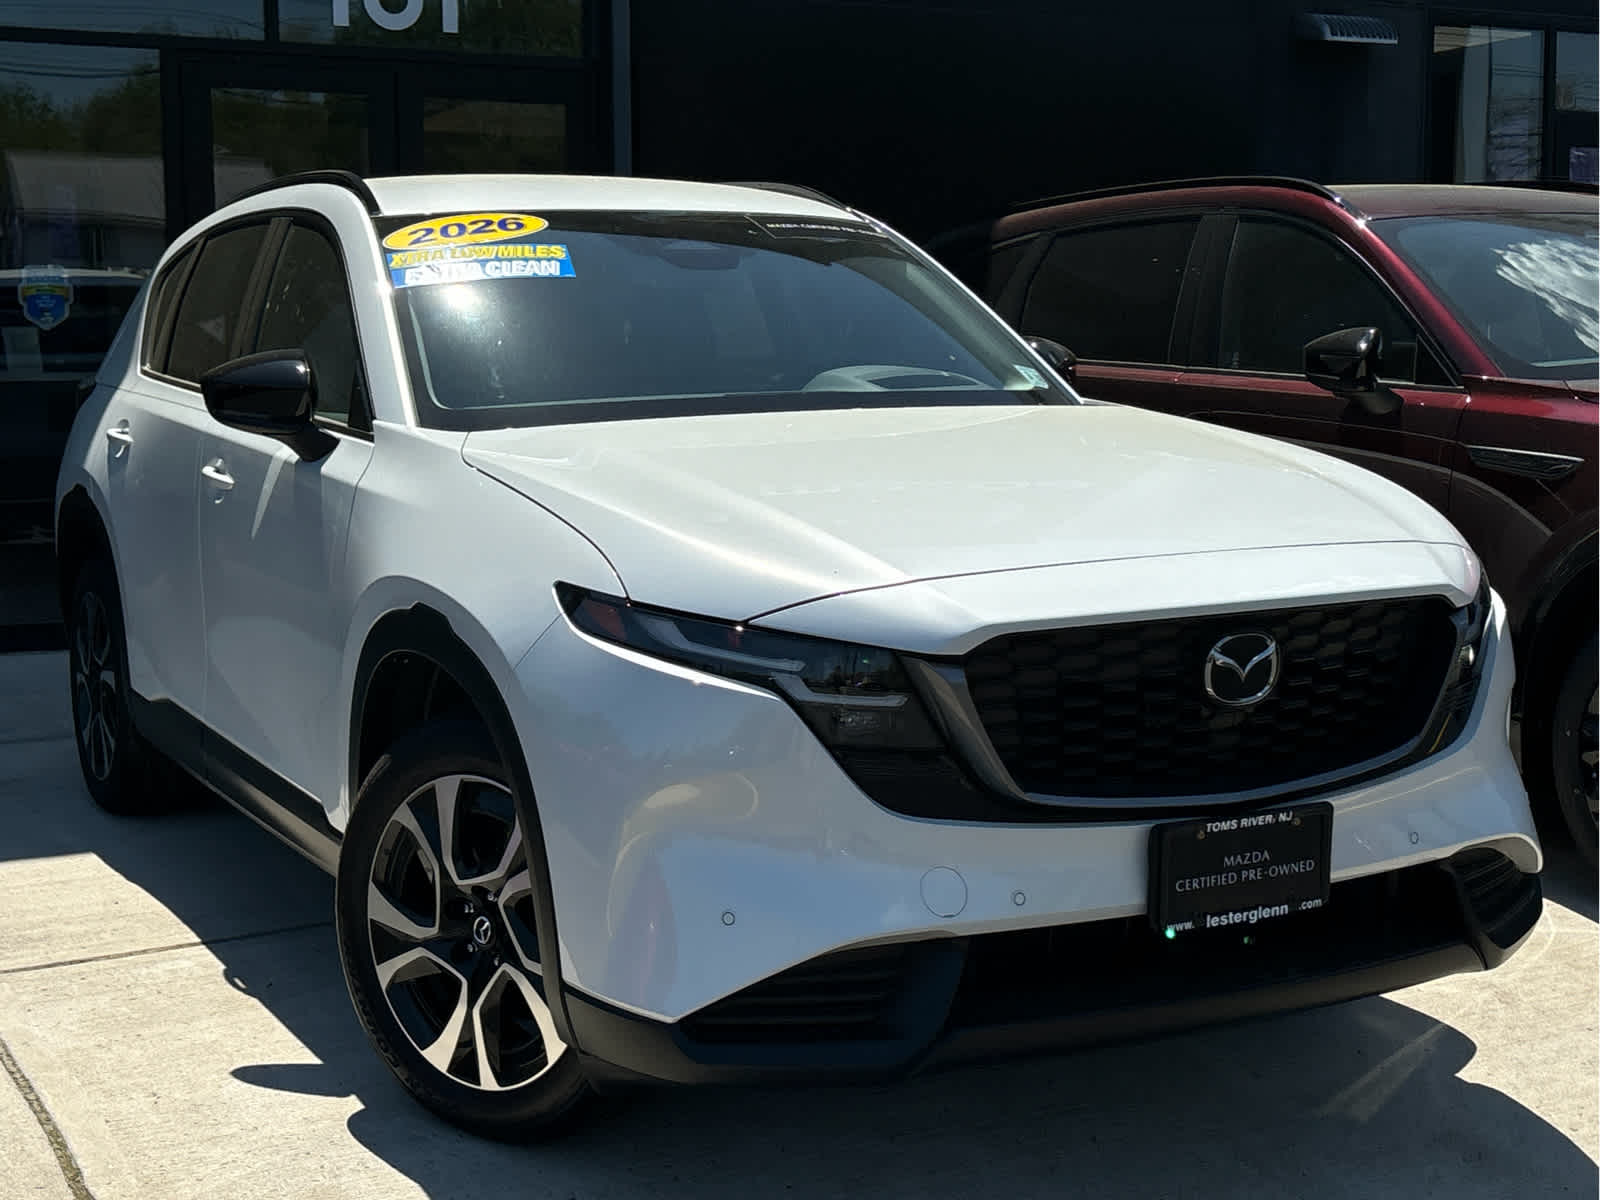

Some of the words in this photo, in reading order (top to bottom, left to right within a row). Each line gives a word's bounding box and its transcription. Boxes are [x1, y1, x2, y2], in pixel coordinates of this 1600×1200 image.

[408, 217, 526, 246] 2026
[449, 245, 497, 262] LOW
[497, 244, 567, 259] MILES
[485, 259, 560, 278] CLEAN
[1206, 819, 1238, 833] TOMS
[1278, 811, 1294, 822] NJ
[1223, 850, 1270, 868] MAZDA
[1175, 871, 1237, 892] CERTIFIED
[1241, 859, 1315, 882] PRE-OWNED
[1206, 903, 1289, 928] lesterglenn
[1298, 898, 1322, 910] .com
